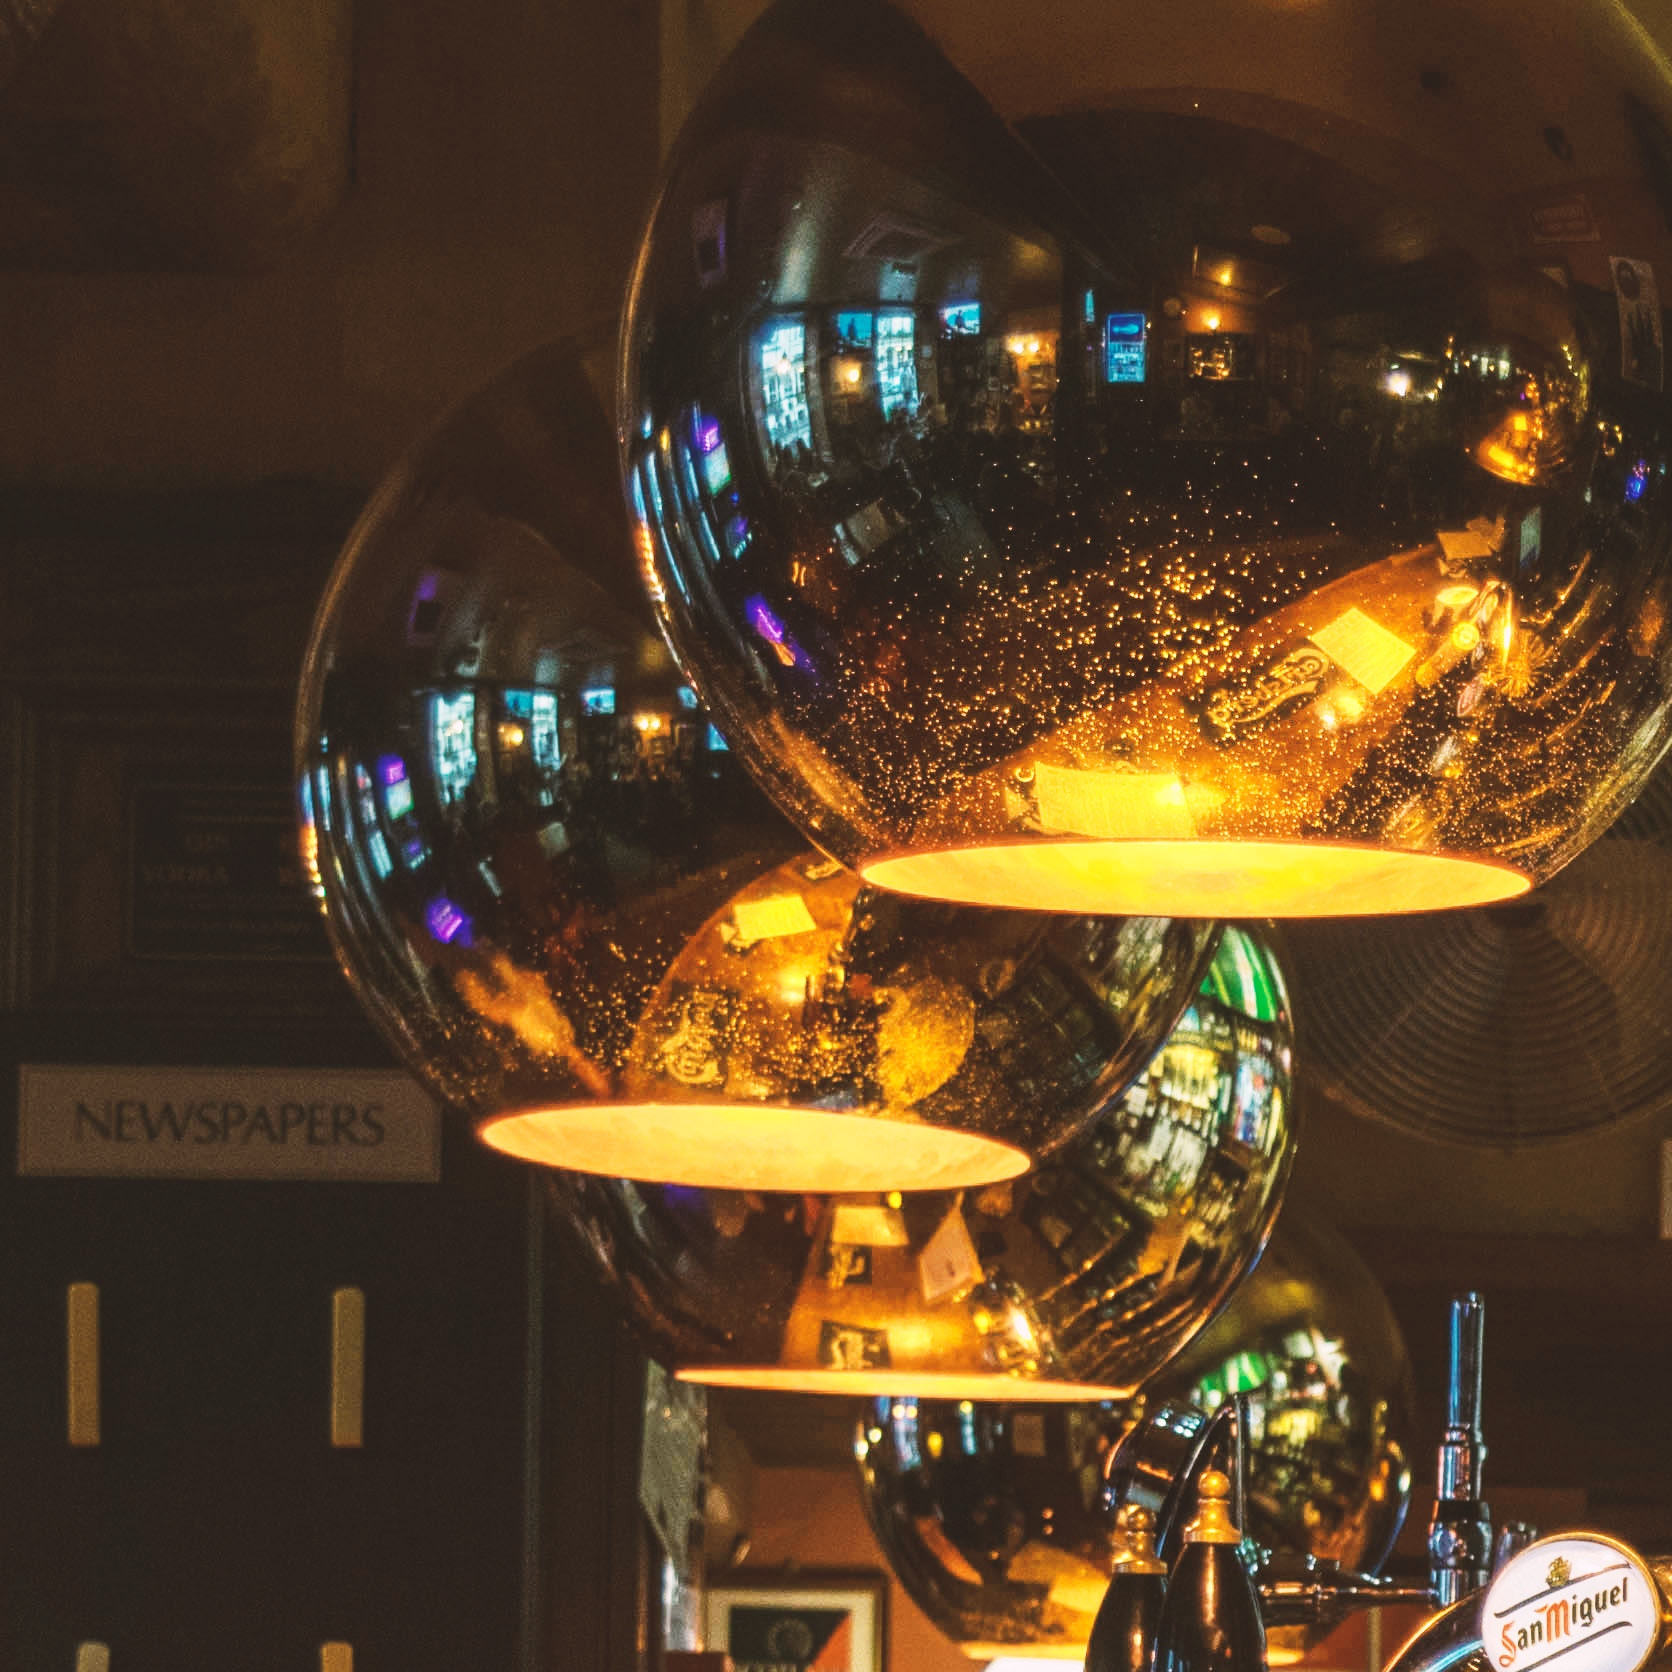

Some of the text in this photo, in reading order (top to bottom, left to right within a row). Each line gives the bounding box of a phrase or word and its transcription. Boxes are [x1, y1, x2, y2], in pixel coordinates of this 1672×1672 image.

[74, 1102, 386, 1146] NEWSPAPERS
[1497, 1576, 1631, 1669] San Miguel
